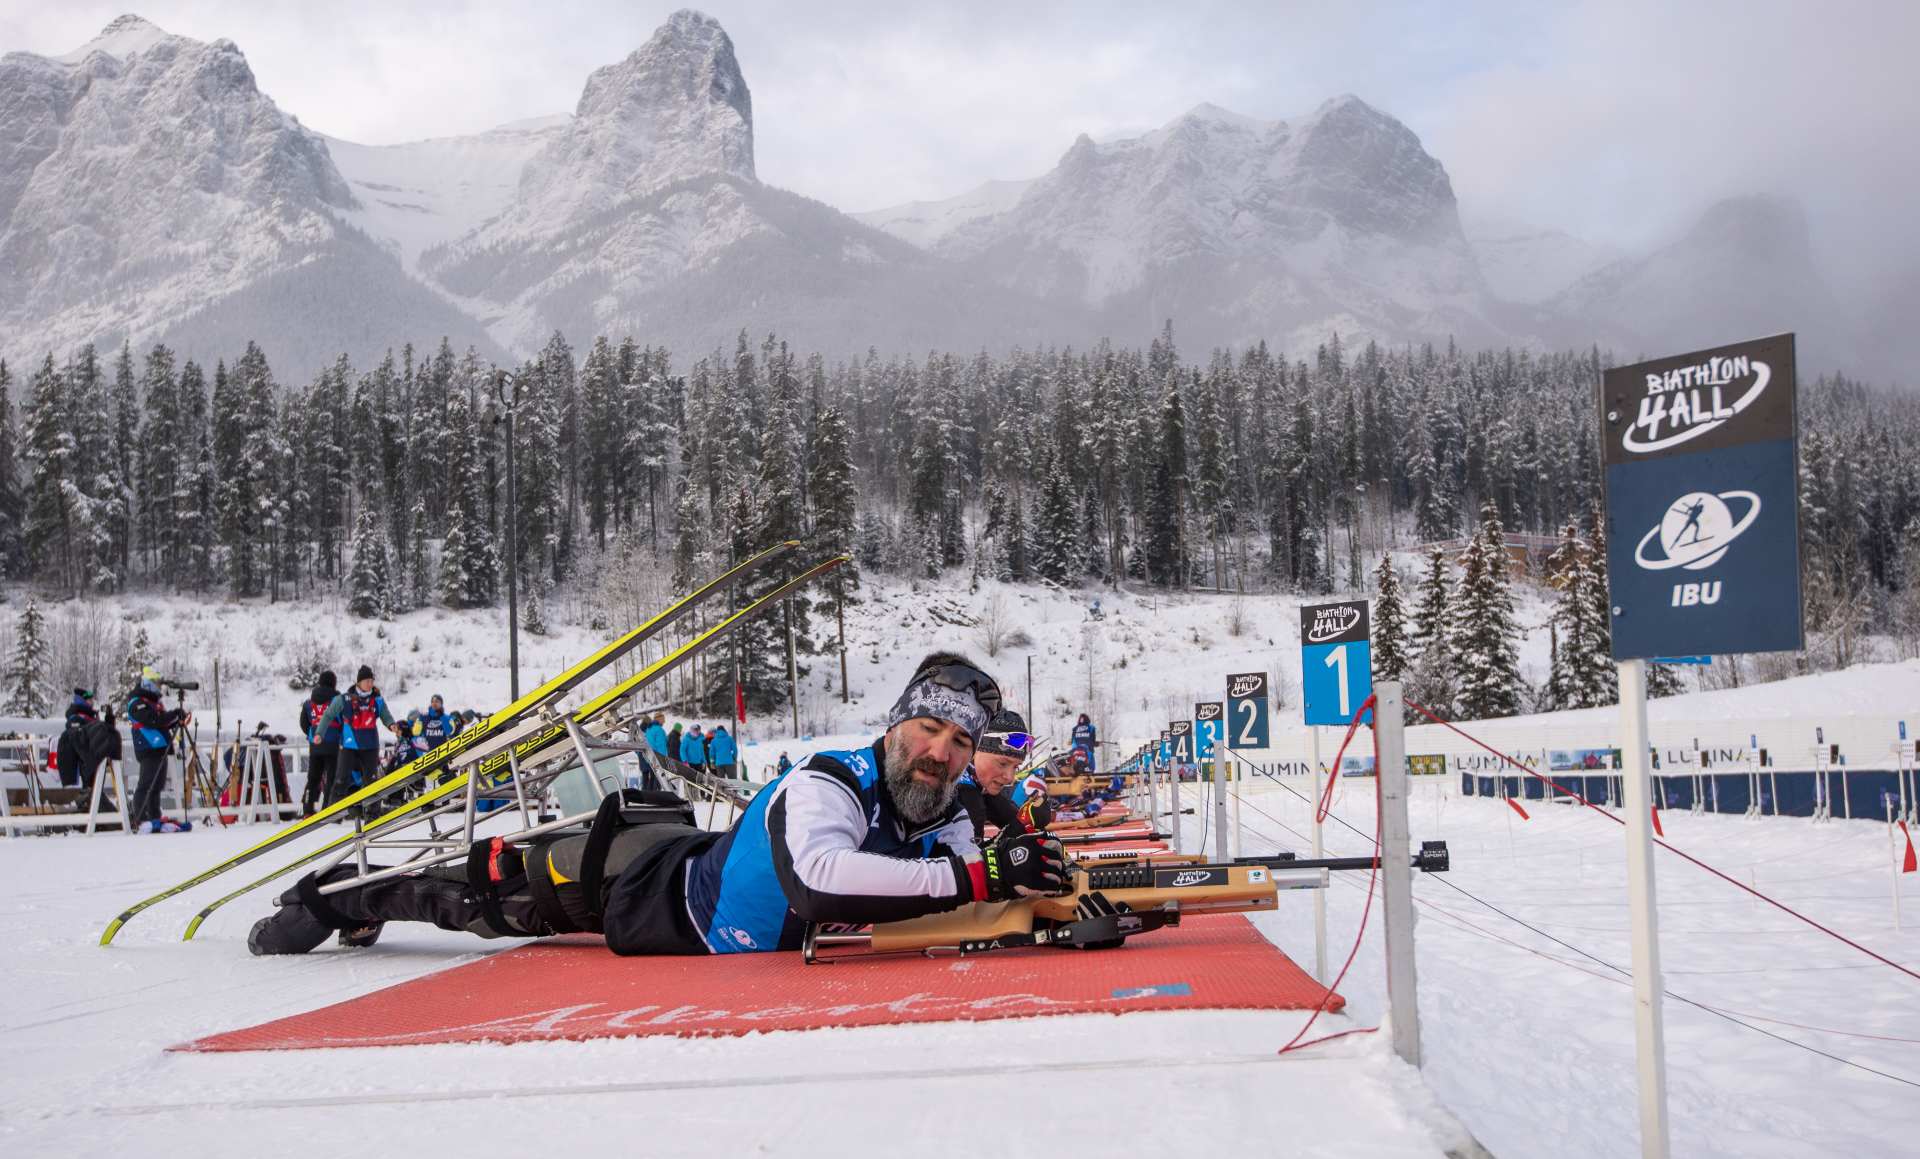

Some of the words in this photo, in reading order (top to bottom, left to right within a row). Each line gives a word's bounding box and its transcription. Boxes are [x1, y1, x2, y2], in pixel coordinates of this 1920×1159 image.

[1636, 386, 1734, 441] 4ALL
[1671, 580, 1721, 607] IBU
[1313, 618, 1348, 637] 4ALL
[1324, 644, 1350, 716] 1
[426, 729, 444, 737] TEAM
[1203, 720, 1217, 754] 3
[1238, 698, 1258, 745] 2
[413, 719, 490, 771] FISCHER
[1175, 735, 1189, 763] 4
[1667, 749, 1750, 764] LUINA
[986, 849, 1000, 880] LEKI
